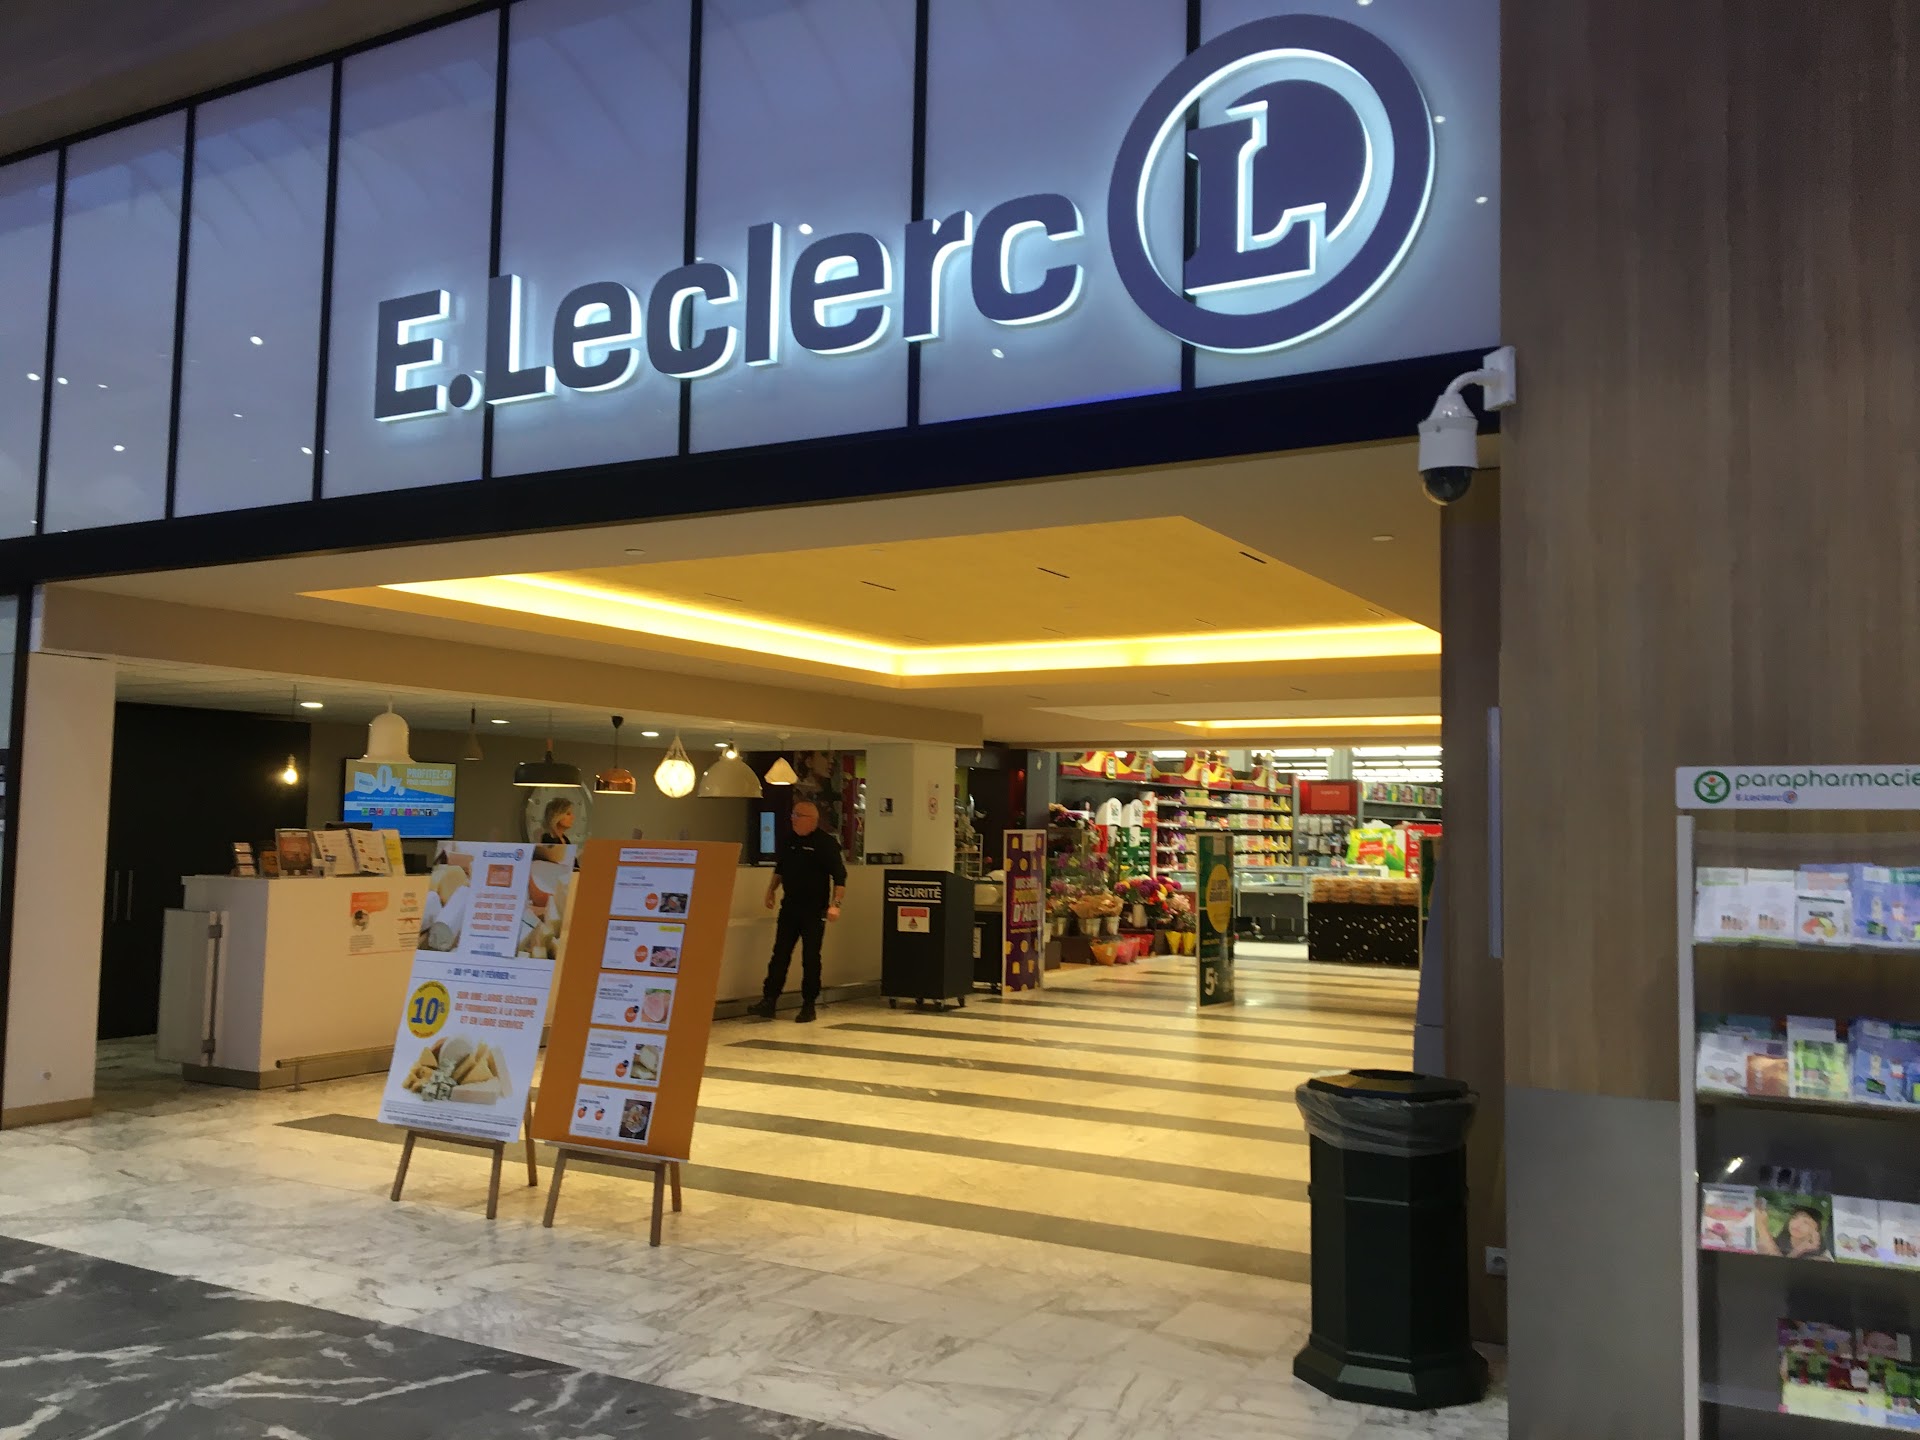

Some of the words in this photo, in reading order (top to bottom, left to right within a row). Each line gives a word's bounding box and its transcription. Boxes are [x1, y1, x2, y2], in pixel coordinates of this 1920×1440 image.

[374, 192, 1086, 424] E.Leclerc
[1735, 768, 1920, 790] parapharmacie
[1736, 793, 1783, 802] E.Leclerc
[888, 885, 942, 899] SÉCURITÉ
[457, 991, 469, 999] SUR
[471, 992, 482, 1000] UNE
[454, 1002, 463, 1011] DE
[464, 1003, 497, 1014] FROMAGES
[513, 1008, 535, 1018] COUPE
[498, 1018, 525, 1029] SERVICE
